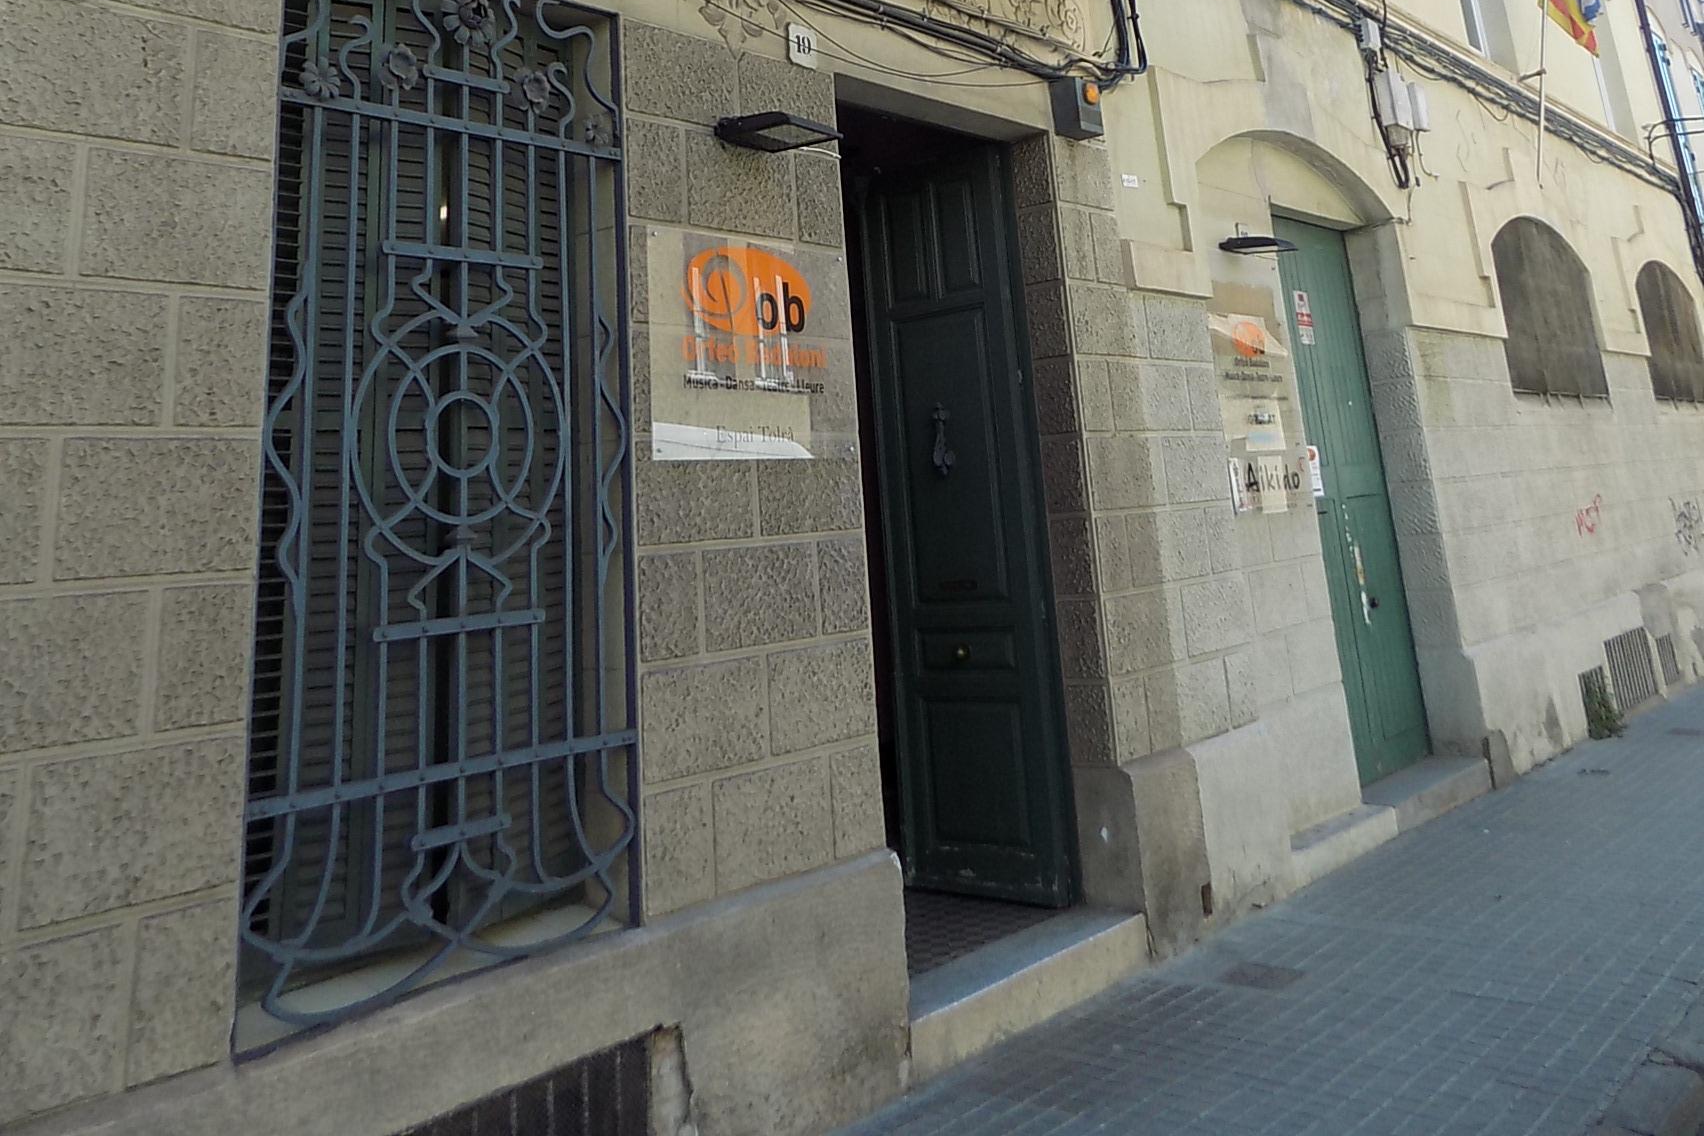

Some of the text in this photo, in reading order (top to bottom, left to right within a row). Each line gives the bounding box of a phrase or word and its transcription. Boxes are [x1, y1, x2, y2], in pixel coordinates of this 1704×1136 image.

[795, 34, 812, 55] 19
[716, 425, 754, 448] Espai
[1245, 462, 1300, 492] Aikido
